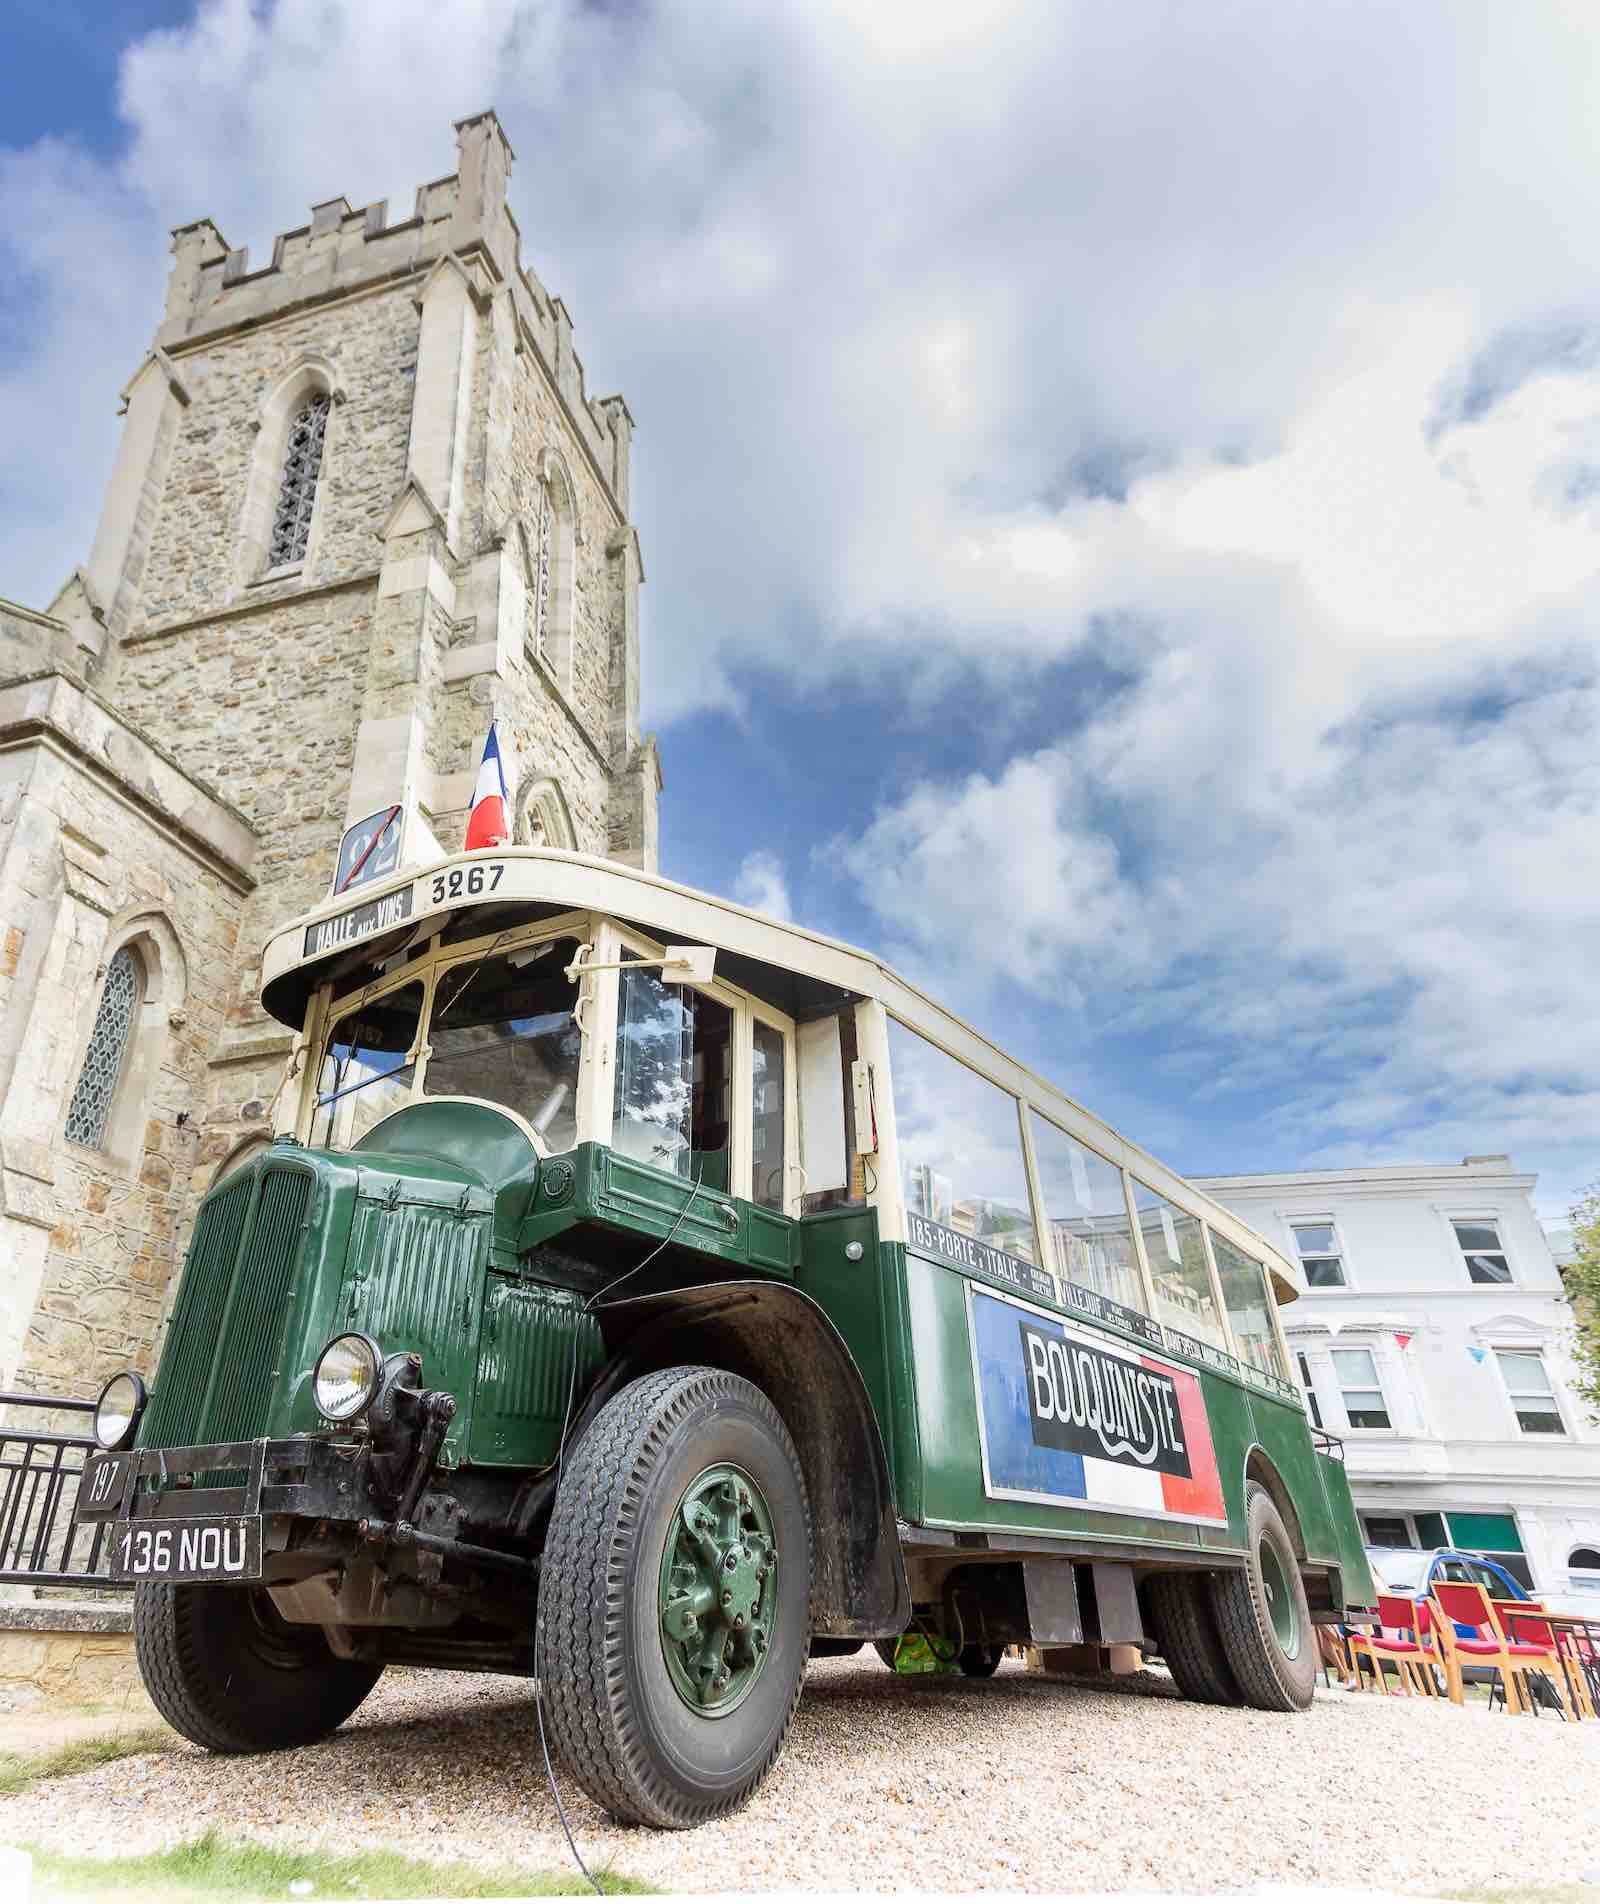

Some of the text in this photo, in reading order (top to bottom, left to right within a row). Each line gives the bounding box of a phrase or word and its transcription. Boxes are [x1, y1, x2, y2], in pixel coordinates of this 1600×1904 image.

[432, 865, 504, 904] 3267
[316, 912, 354, 953] HALLE
[377, 893, 403, 930] VINS
[1027, 1332, 1185, 1465] BOUQUINISTE
[89, 1460, 120, 1501] 197
[121, 1527, 247, 1574] 136 NOU
